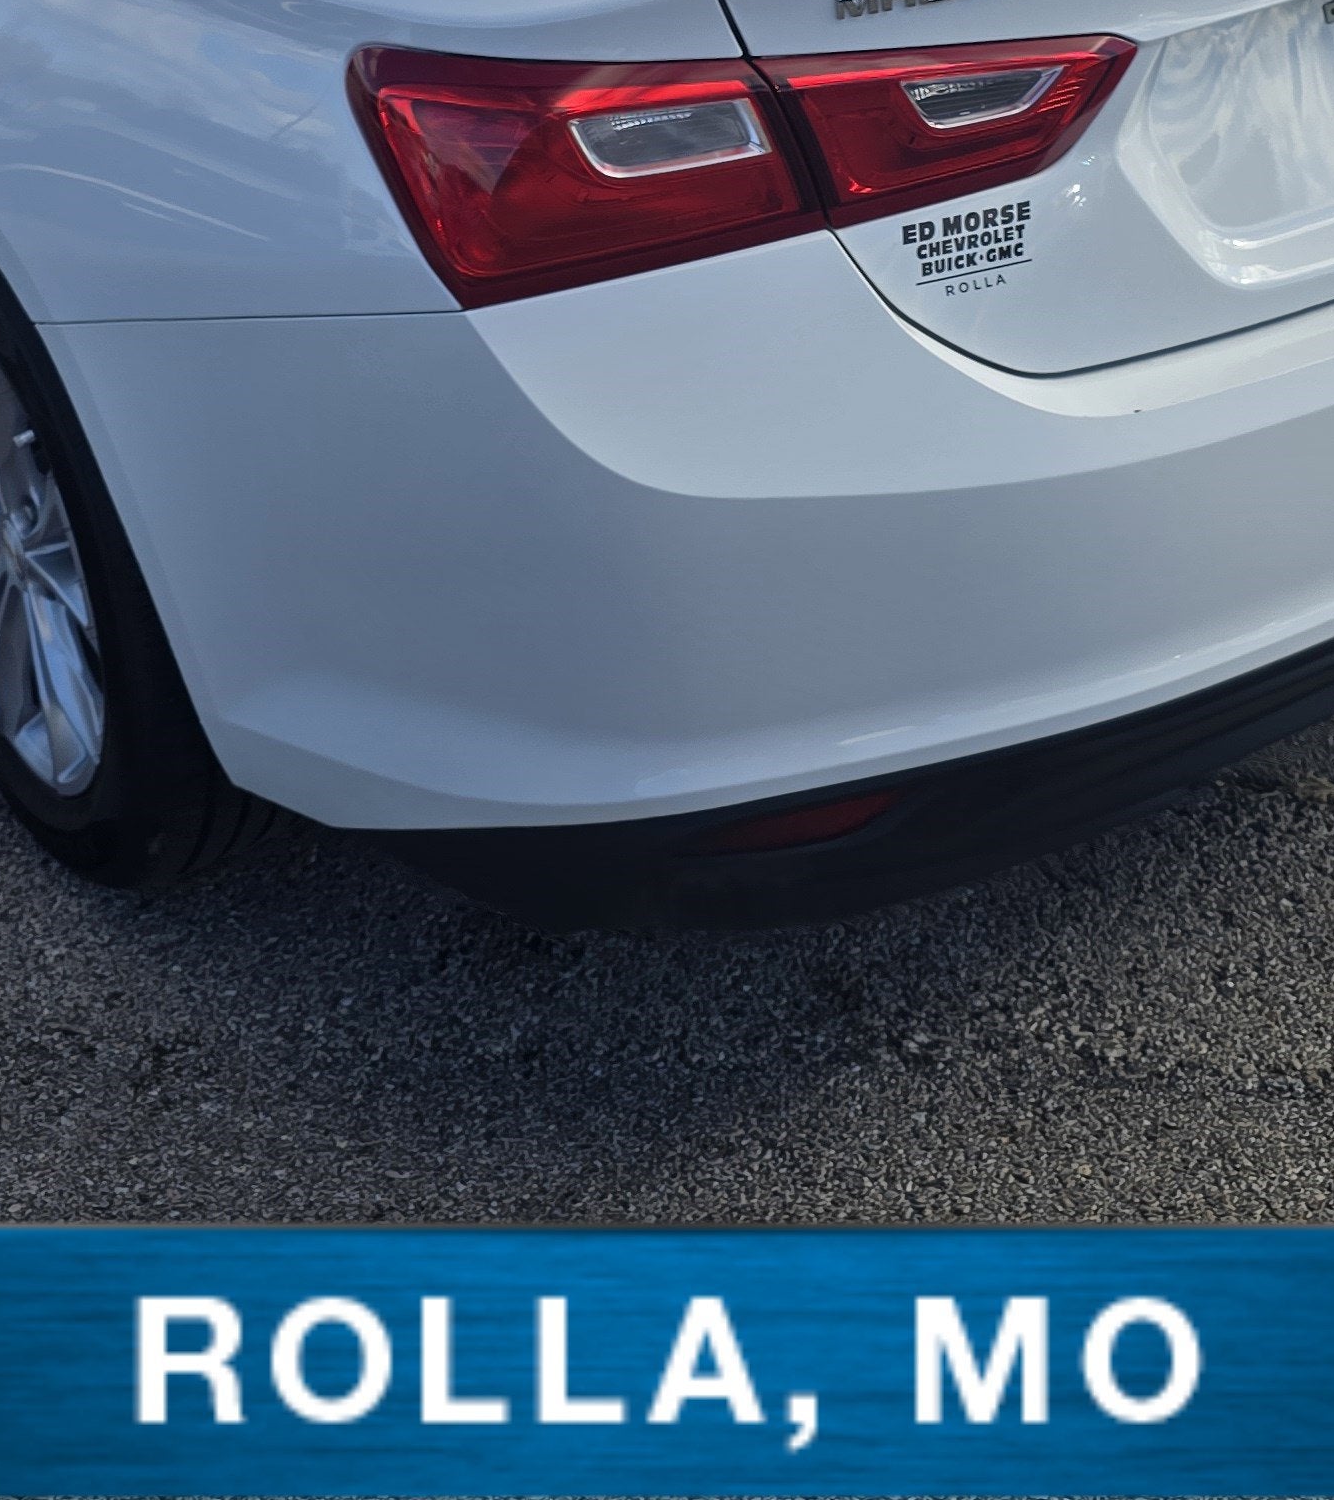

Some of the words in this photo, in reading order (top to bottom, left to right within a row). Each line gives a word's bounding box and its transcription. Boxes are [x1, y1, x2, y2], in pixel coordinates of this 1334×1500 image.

[901, 221, 936, 246] ED
[942, 200, 1032, 237] MORSE
[916, 223, 1026, 260] CHEVROLET
[944, 273, 1007, 297] ROLLA
